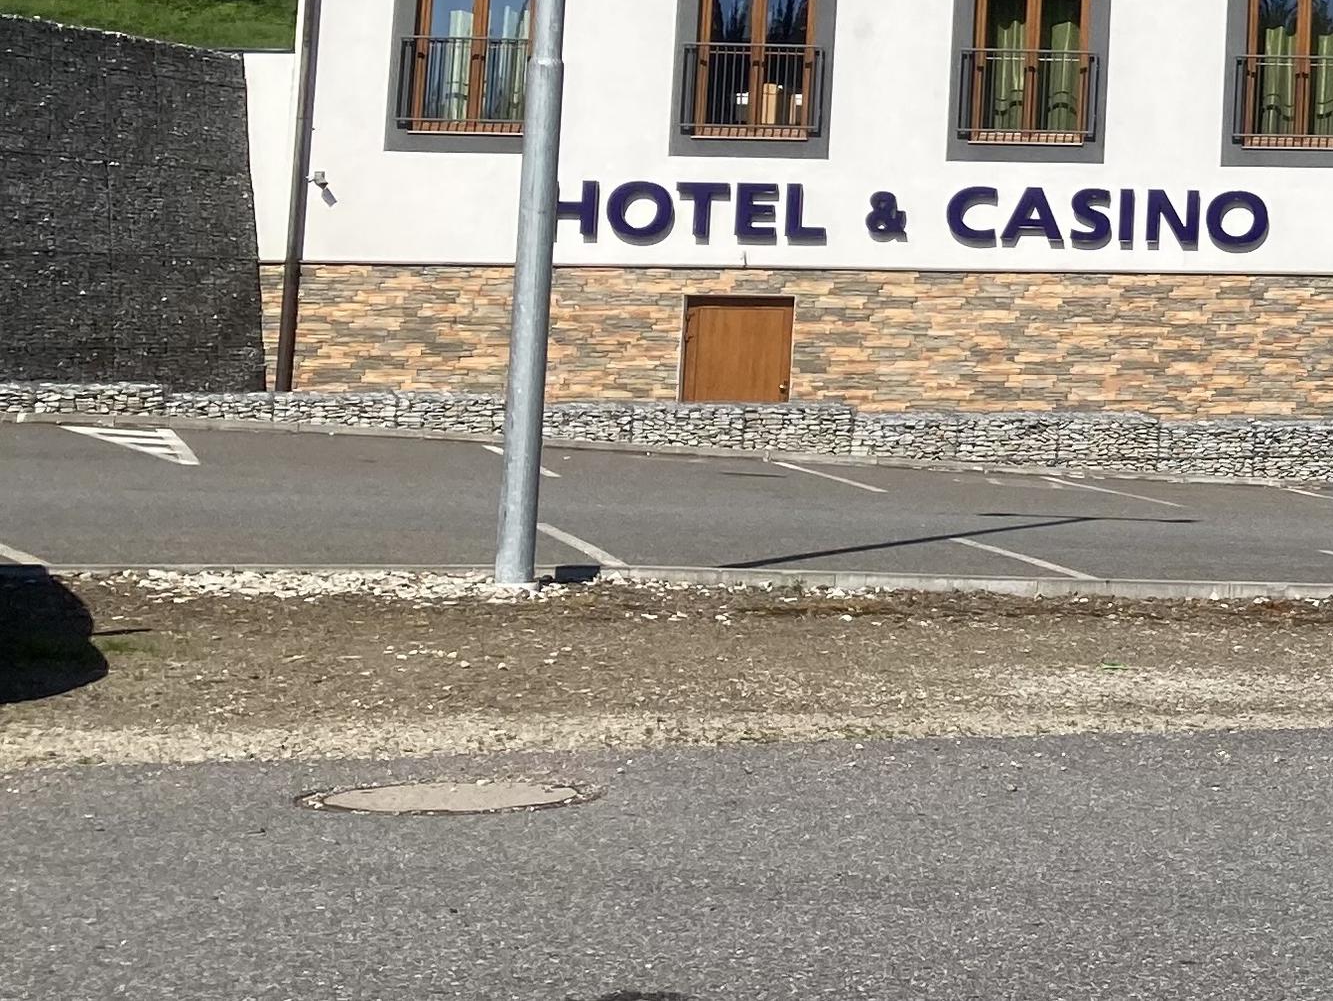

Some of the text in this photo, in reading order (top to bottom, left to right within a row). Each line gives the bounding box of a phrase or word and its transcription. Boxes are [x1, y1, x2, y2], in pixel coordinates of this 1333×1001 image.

[554, 180, 827, 245] HOTEL
[865, 190, 907, 242] &
[946, 186, 1269, 253] CASINO
